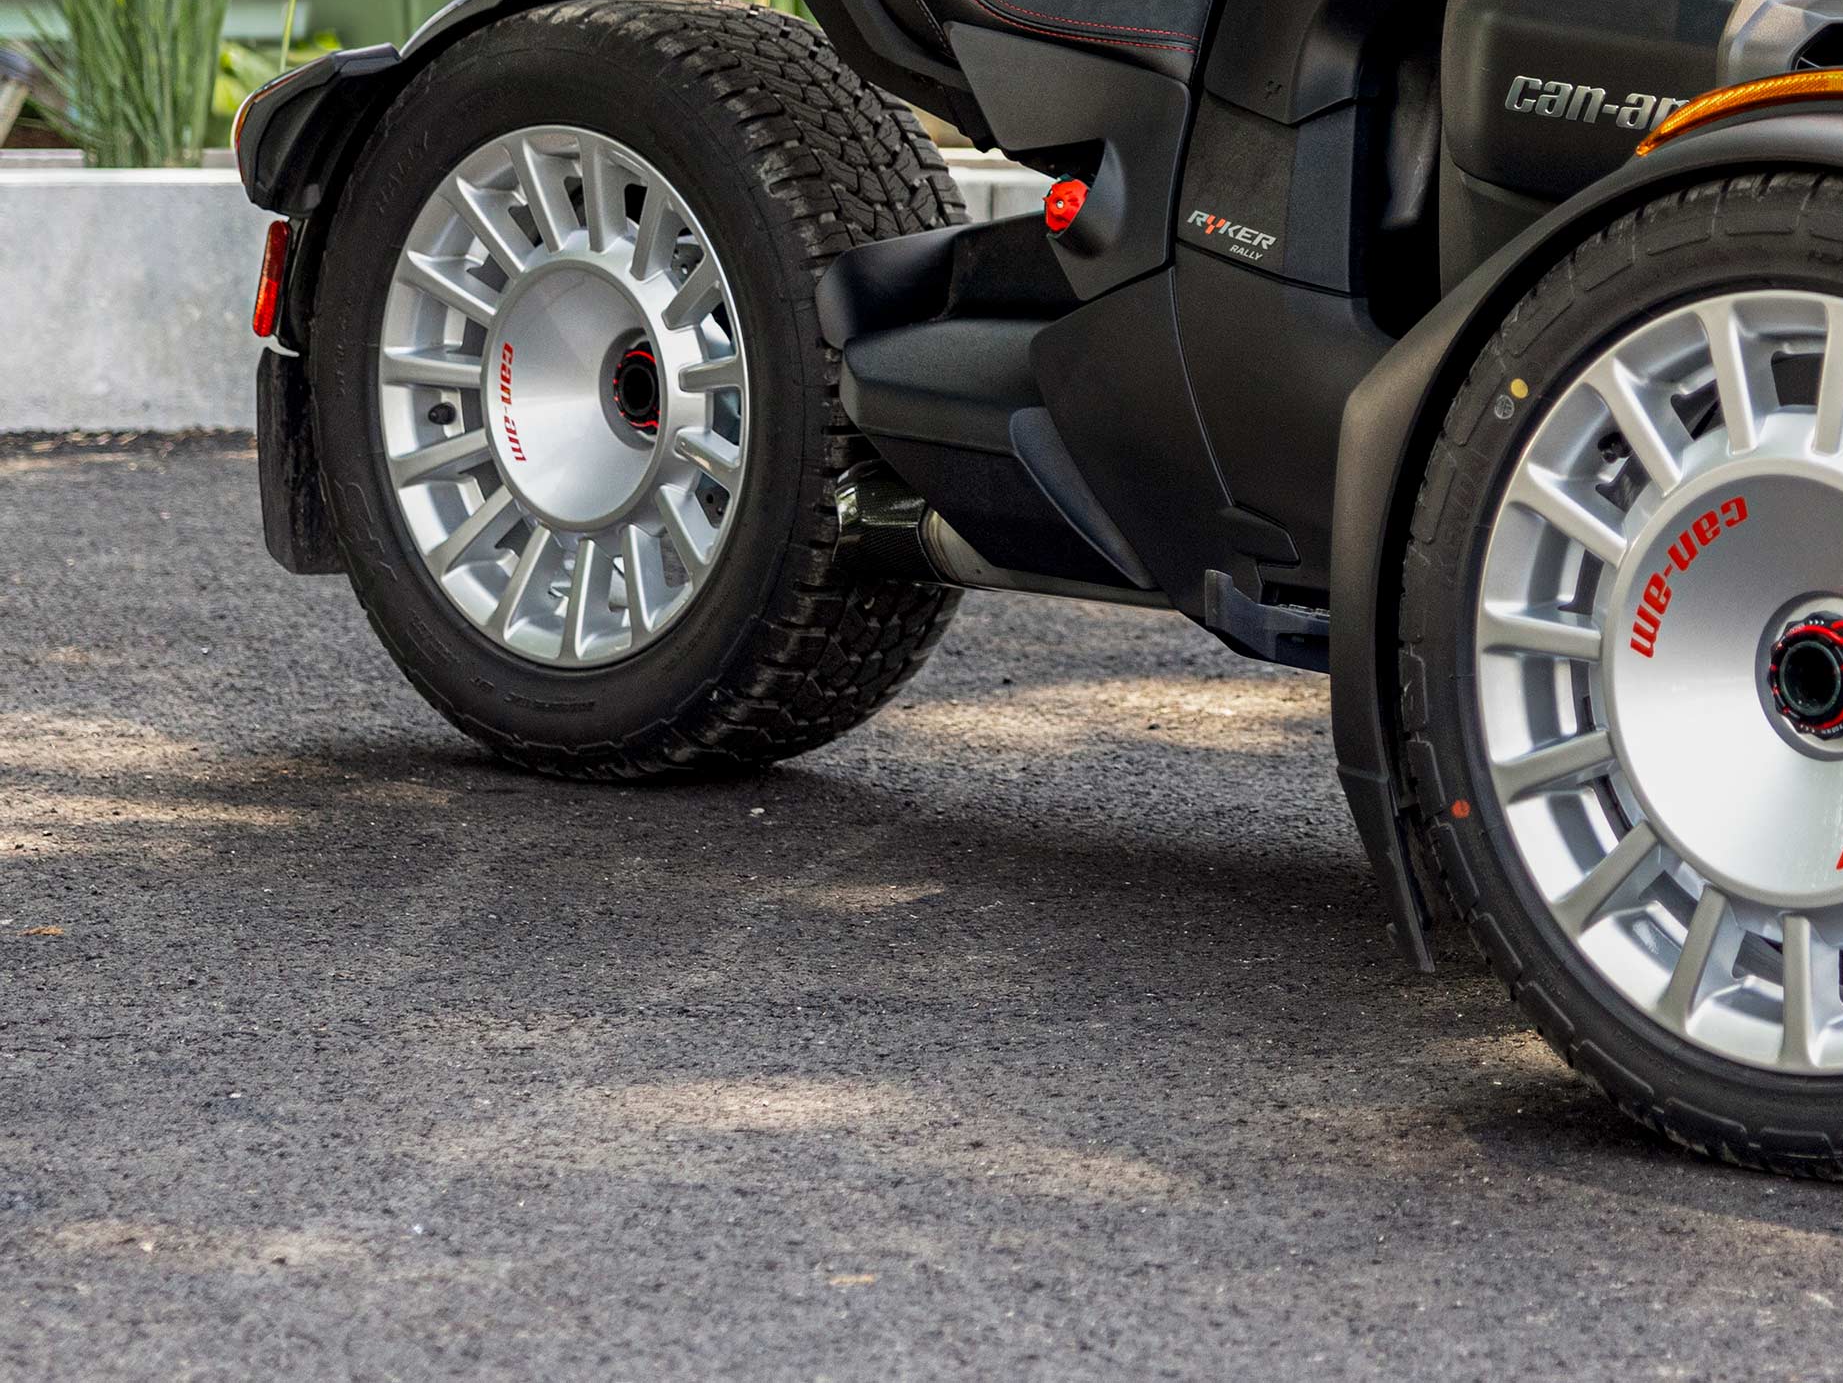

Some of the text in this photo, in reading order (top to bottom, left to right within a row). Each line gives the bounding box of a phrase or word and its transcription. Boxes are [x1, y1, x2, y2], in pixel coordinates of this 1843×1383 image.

[1187, 210, 1277, 250] RYKER
[1229, 244, 1263, 261] RALLY
[500, 341, 527, 462] can-am
[1630, 496, 1749, 658] can-am
